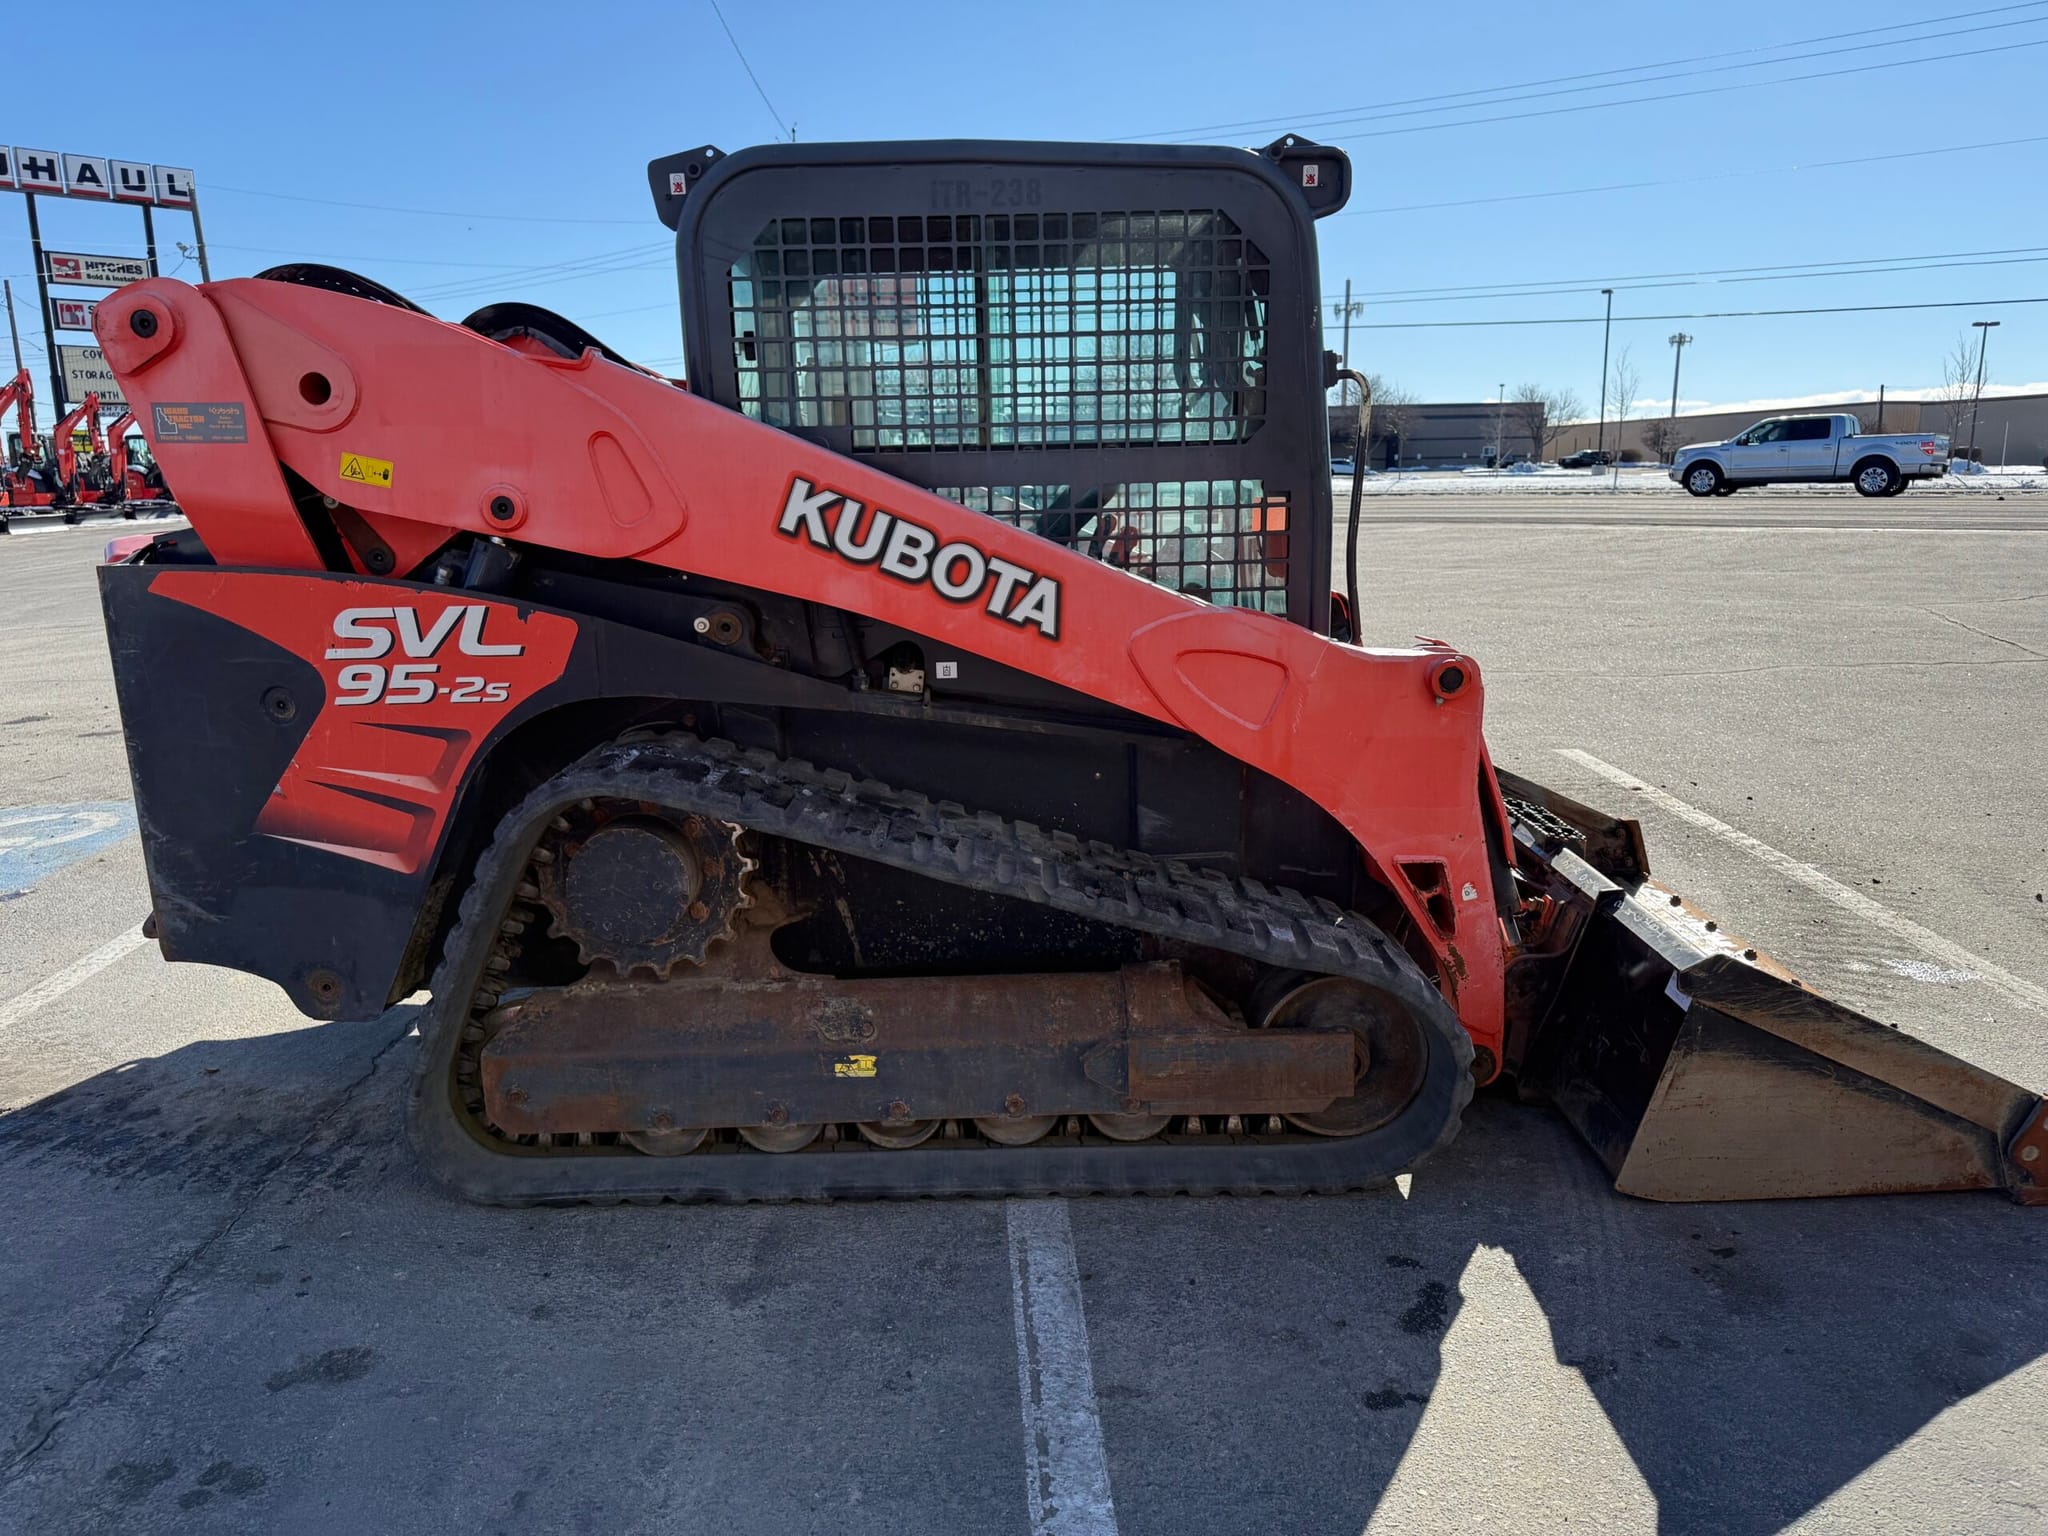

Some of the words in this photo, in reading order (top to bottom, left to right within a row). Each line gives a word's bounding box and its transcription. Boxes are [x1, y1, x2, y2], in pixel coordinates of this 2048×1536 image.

[85, 261, 143, 275] HITCHES
[86, 273, 103, 281] Sold
[82, 350, 104, 359] COV
[72, 370, 114, 380] STORAG
[779, 477, 1059, 639] KUBOTA
[324, 605, 525, 660] SVL
